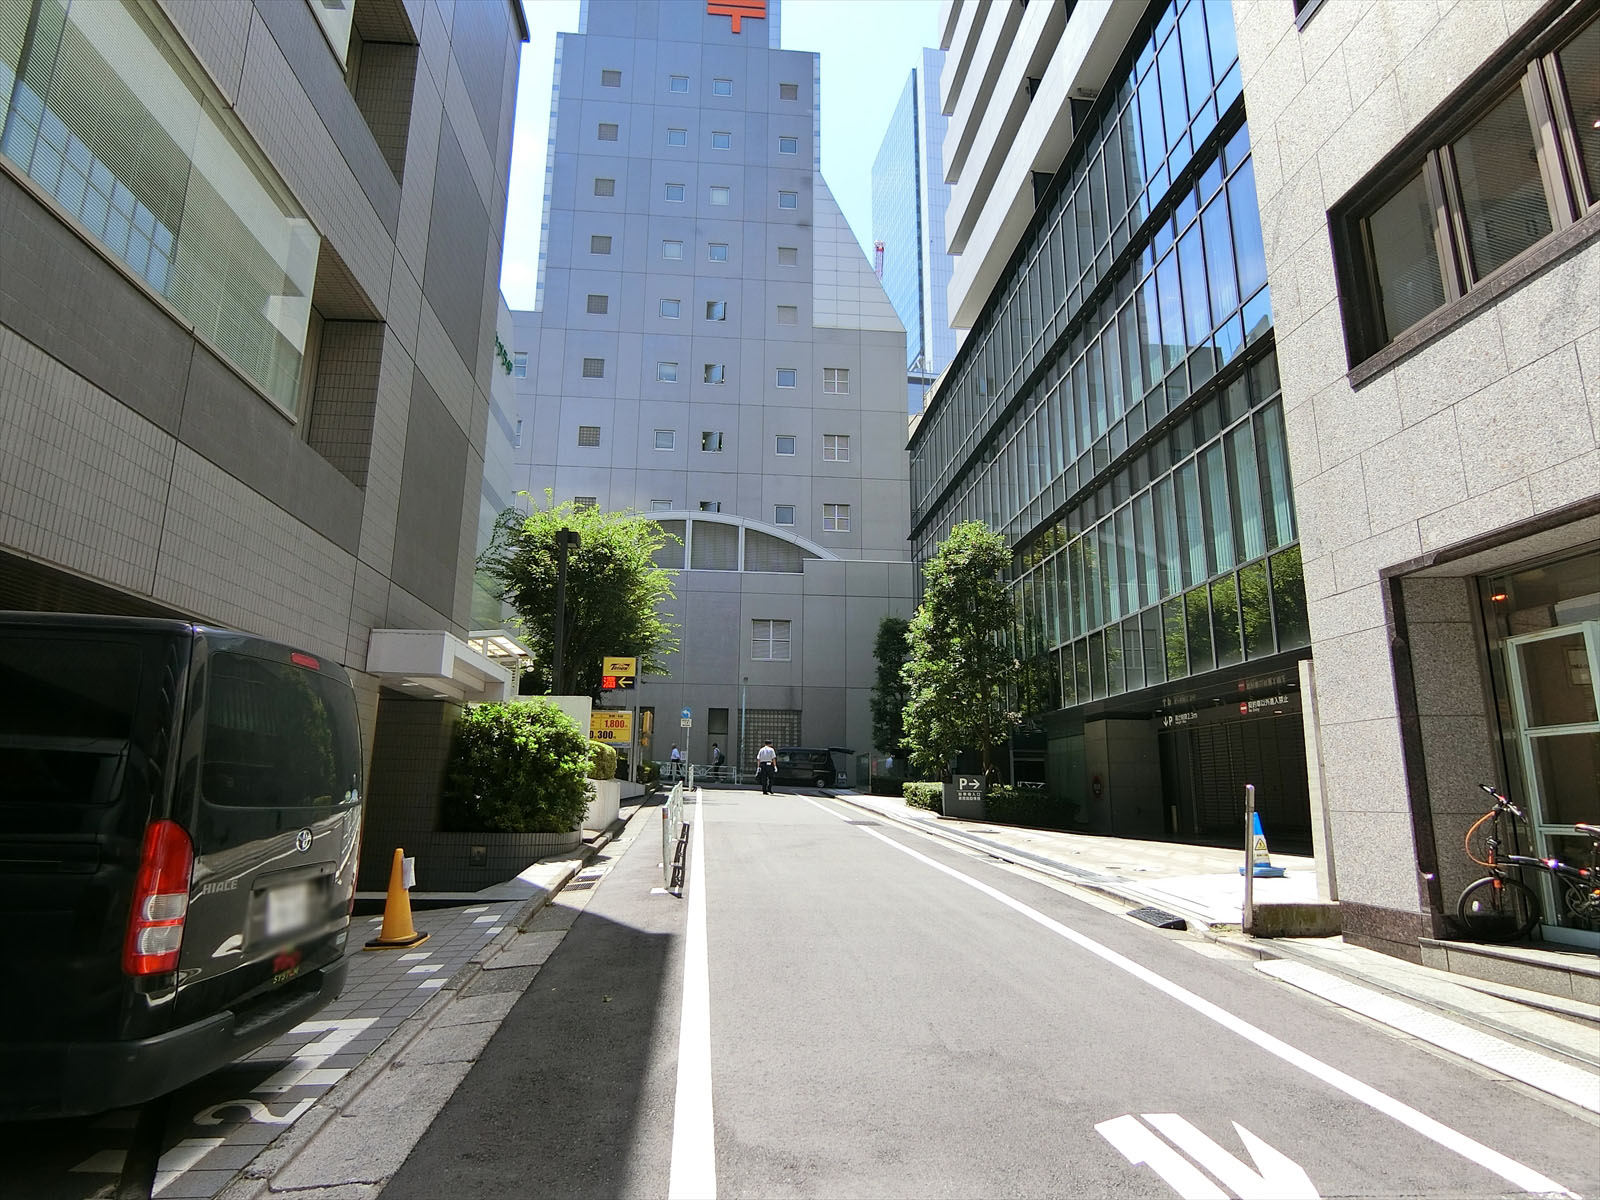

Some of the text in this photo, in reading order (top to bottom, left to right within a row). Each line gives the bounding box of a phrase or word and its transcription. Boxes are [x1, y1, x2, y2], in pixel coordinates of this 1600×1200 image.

[1168, 715, 1173, 727] P
[959, 777, 968, 790] P
[202, 879, 238, 896] HIACE
